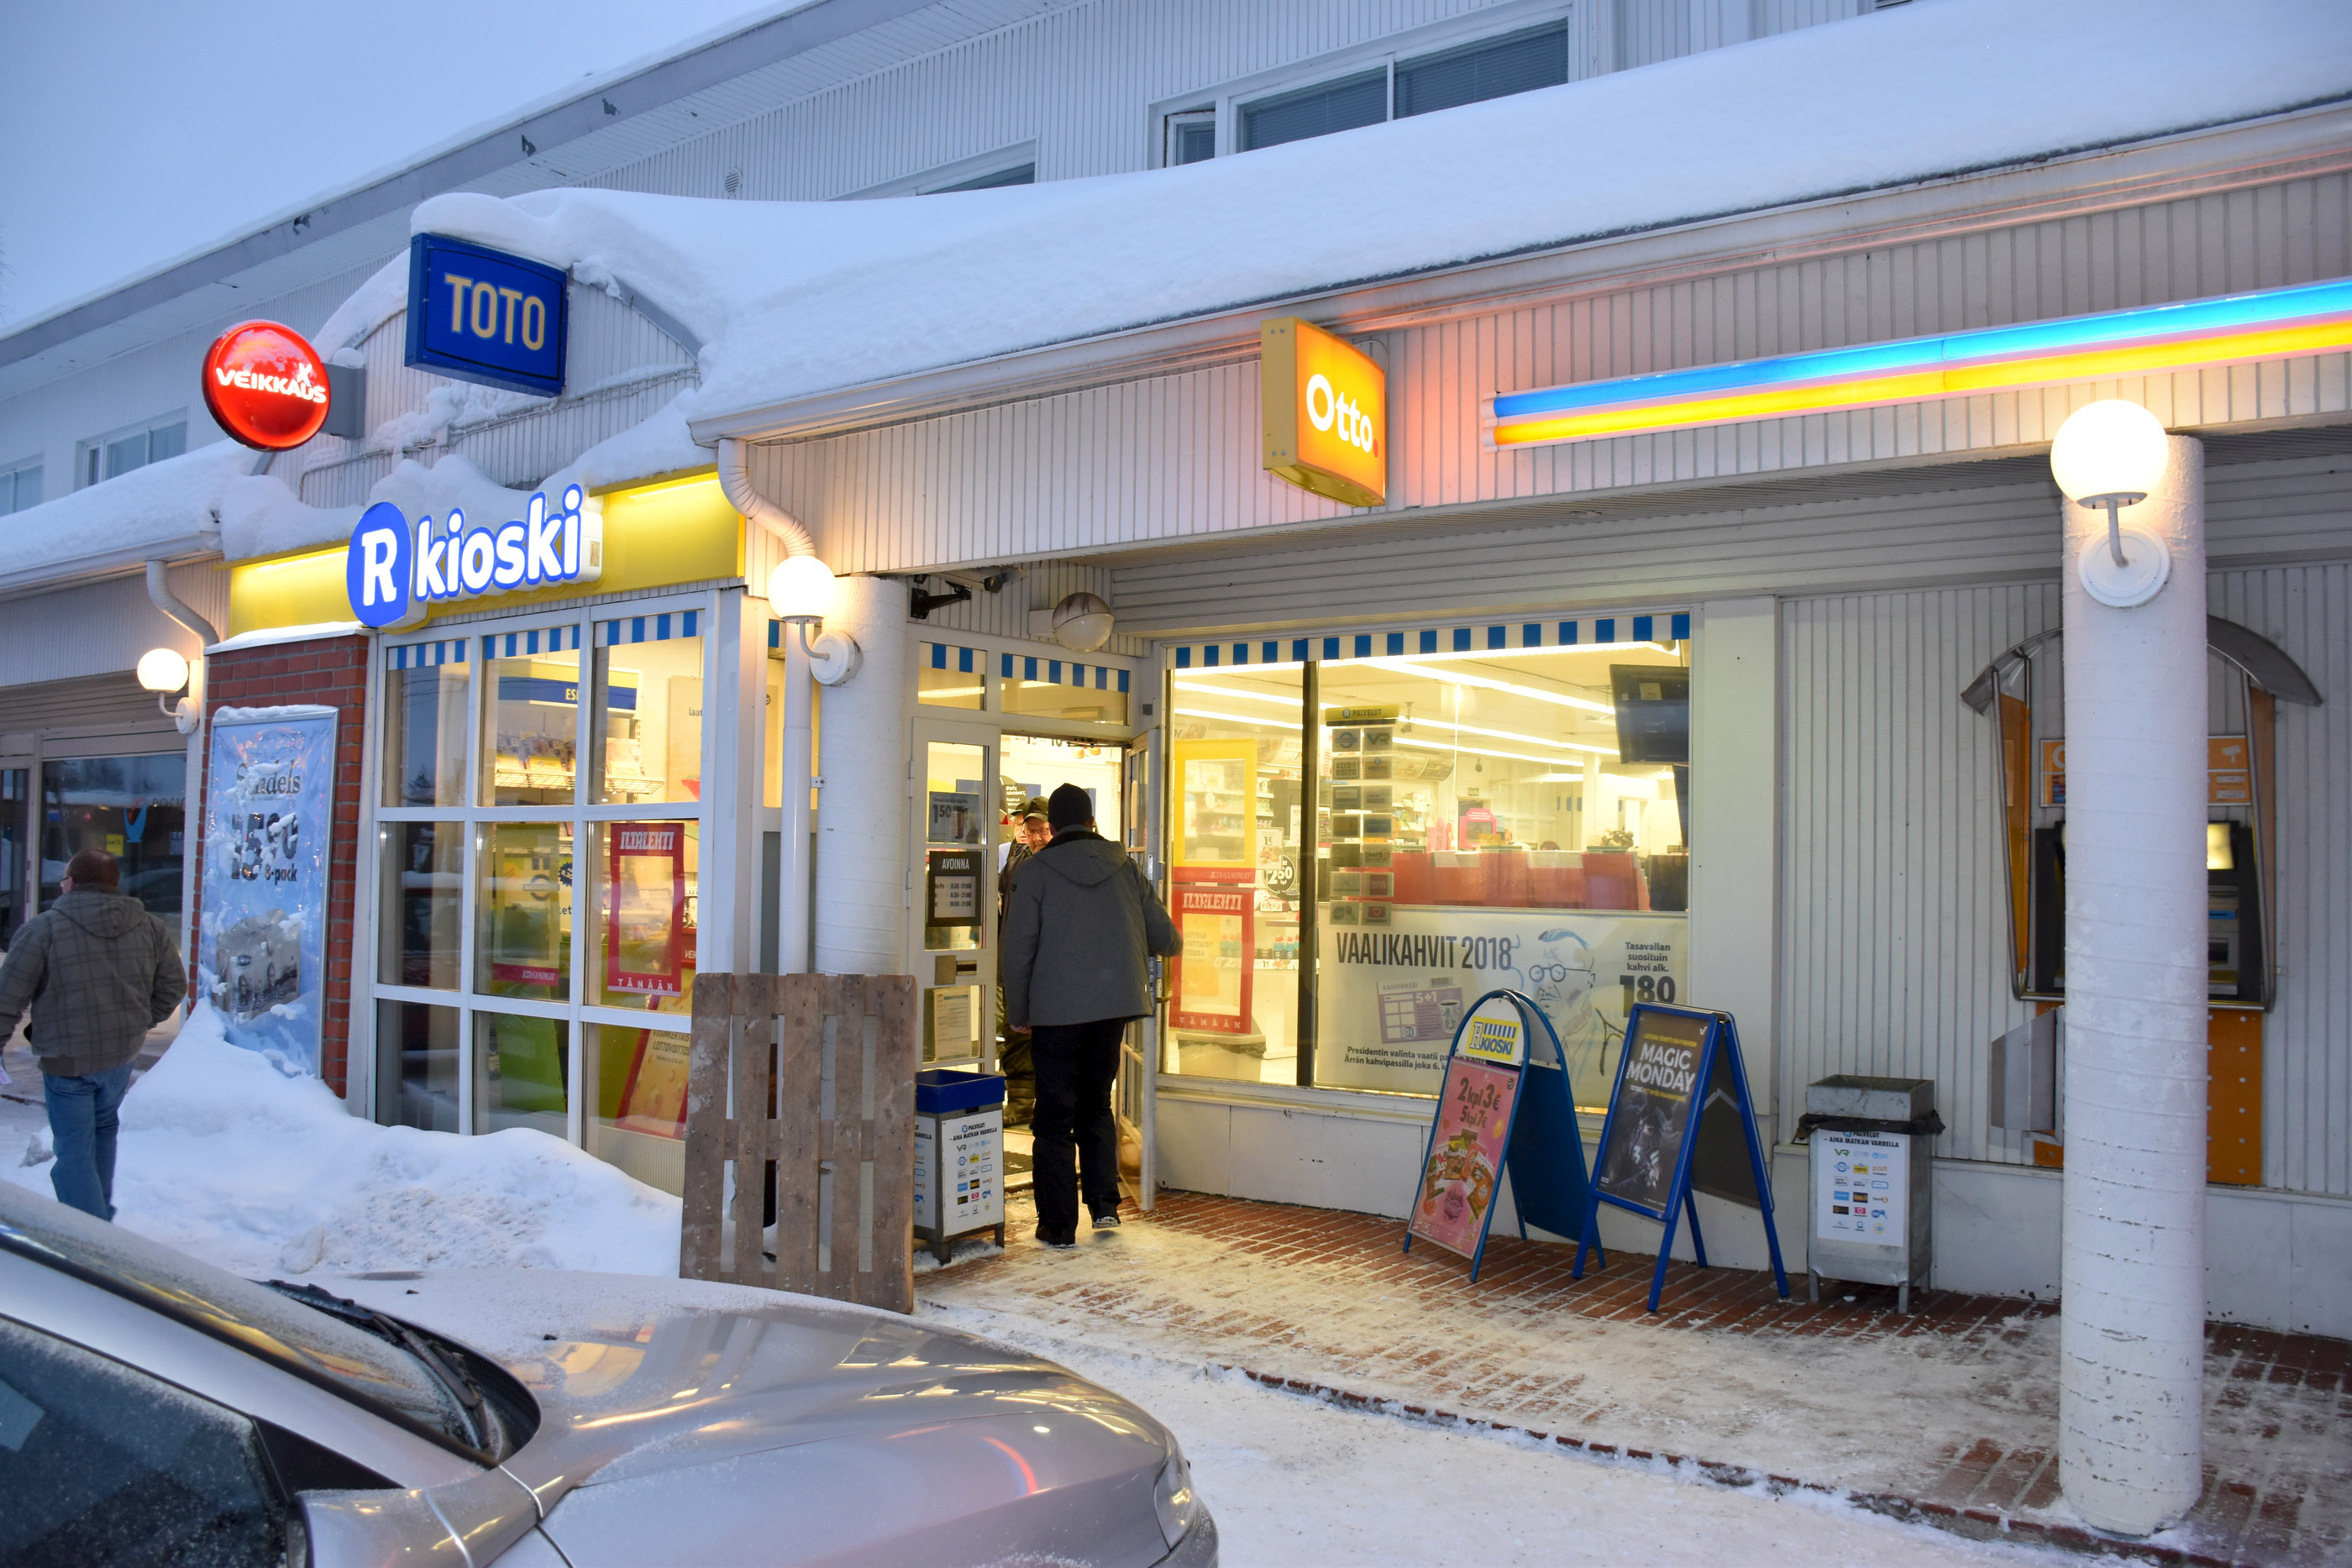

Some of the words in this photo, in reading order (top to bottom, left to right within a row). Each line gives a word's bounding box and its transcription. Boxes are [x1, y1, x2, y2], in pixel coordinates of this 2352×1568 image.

[444, 274, 546, 351] TOTO
[215, 364, 328, 404] VEIKKAUS
[361, 527, 398, 607] R
[416, 484, 582, 600] kioski
[1352, 709, 1383, 717] PALVELUT
[1366, 732, 1391, 746] VR
[235, 758, 301, 796] Sndels
[619, 831, 675, 852] ILTALEHTI
[942, 858, 970, 870] AVOINNA
[265, 863, 298, 886] 8-pack
[1183, 892, 1243, 910] ILTALEHTI
[559, 906, 573, 915] et
[1336, 931, 1457, 968] VAALIKAHVIT
[1461, 936, 1513, 972] 2018
[1625, 941, 1671, 952] Tasavallan
[1627, 952, 1668, 962] suosituin
[1626, 962, 1651, 972] kahvi
[1652, 963, 1669, 973] alk.
[617, 976, 674, 992] TÄNÄÄN
[1382, 982, 1419, 991] KAHVIPASSI
[1415, 991, 1438, 1004] 5+1
[1619, 974, 1676, 1018] 180
[1347, 1046, 1389, 1057] Presidentin
[1389, 1050, 1415, 1059] valinta
[1416, 1052, 1438, 1061] vaatii
[1480, 1036, 1513, 1056] KIOSKI
[1344, 1053, 1365, 1064] Ärrän
[1365, 1057, 1414, 1068] kahvipassilla
[1414, 1061, 1431, 1070] joka
[1640, 1042, 1693, 1070] MAGIC
[1625, 1060, 1696, 1093] MONDAY
[963, 1131, 979, 1140] MATKAN
[979, 1126, 997, 1135] VARRELLA
[969, 1122, 985, 1130] PALVELUT
[1871, 1140, 1899, 1148] VARRELLA
[1834, 1148, 1850, 1156] VR
